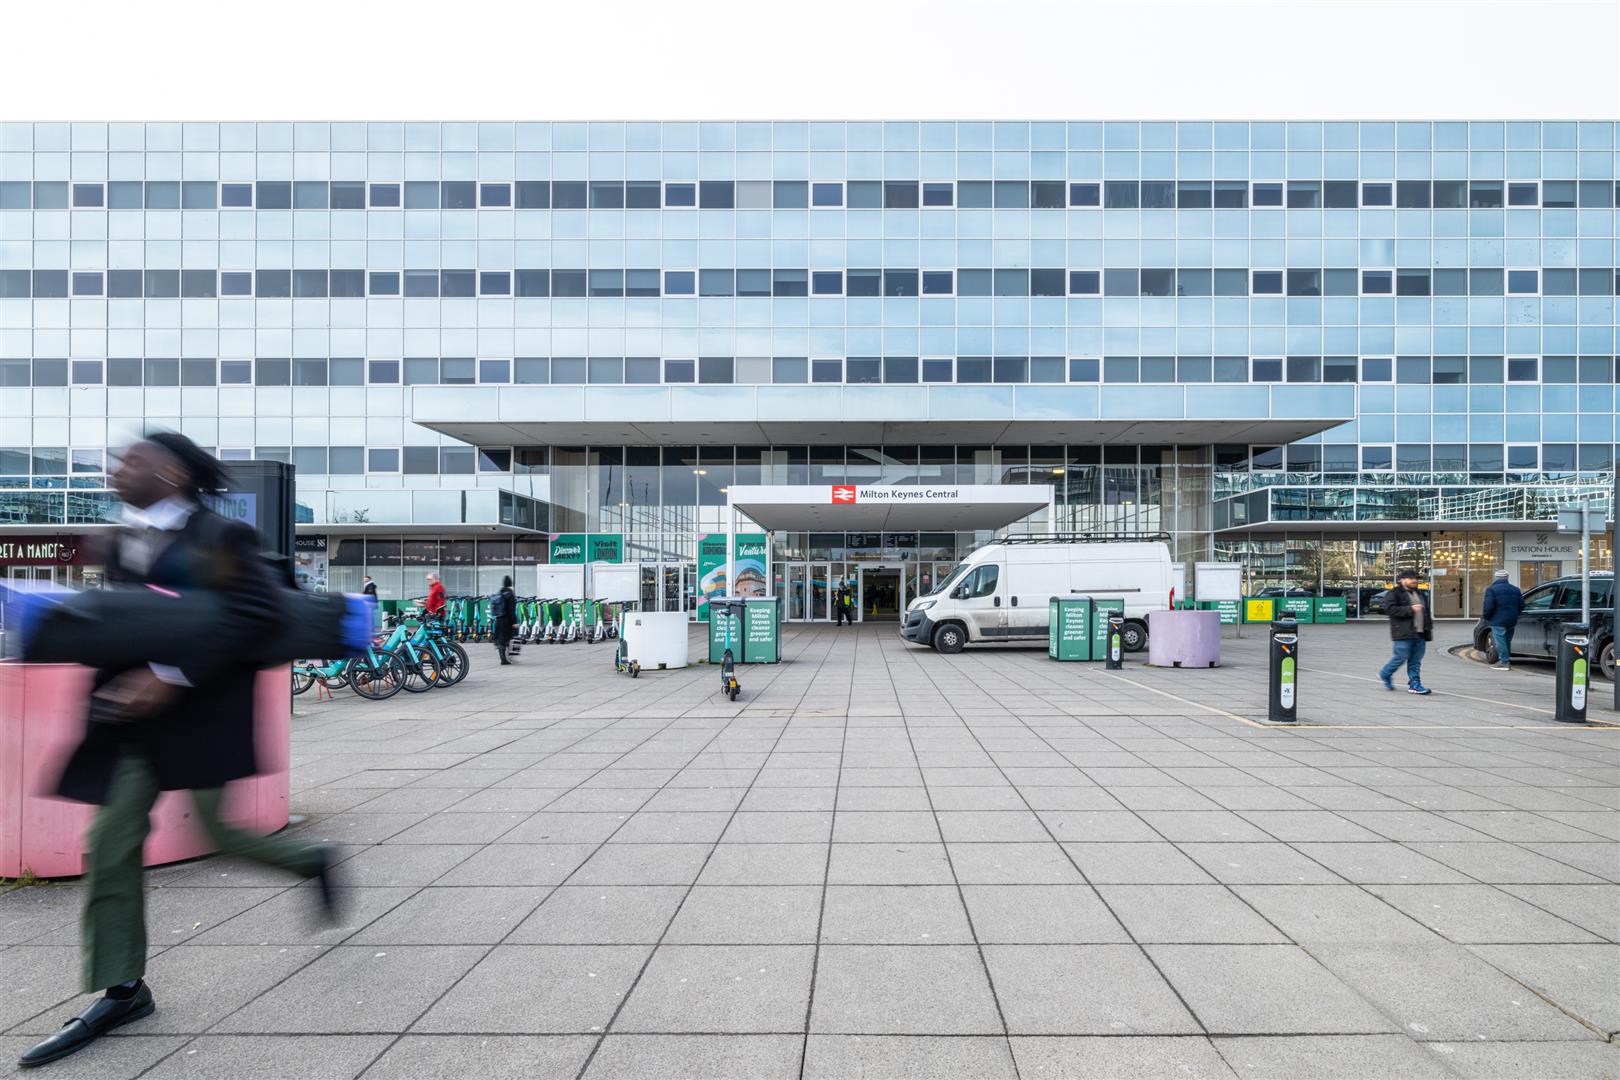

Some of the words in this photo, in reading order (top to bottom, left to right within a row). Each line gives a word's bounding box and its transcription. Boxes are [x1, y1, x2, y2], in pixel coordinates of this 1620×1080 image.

[860, 490, 889, 498] Milton
[891, 490, 923, 500] Keynes
[925, 490, 958, 498] Central
[17, 544, 24, 558] A
[27, 543, 64, 558] MANG
